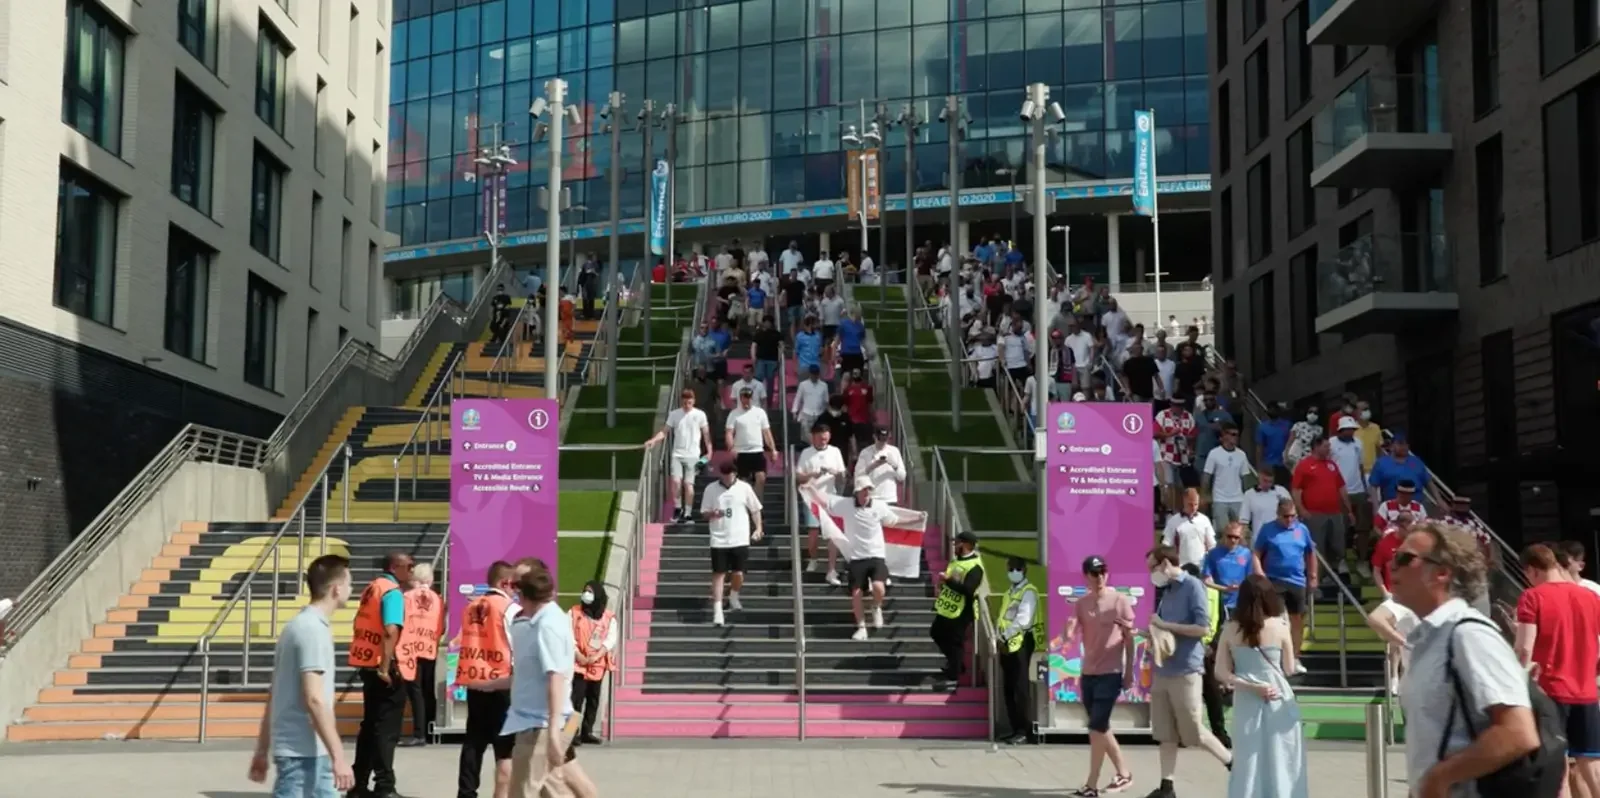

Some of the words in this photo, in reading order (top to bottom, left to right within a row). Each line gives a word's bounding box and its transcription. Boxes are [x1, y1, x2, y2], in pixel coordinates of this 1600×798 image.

[1139, 138, 1149, 197] Entrance
[913, 196, 941, 208] UEFA
[941, 194, 969, 206] EO
[969, 192, 996, 204] 2020
[654, 182, 667, 238] Entrance
[700, 214, 724, 226] UEFA
[723, 212, 749, 224] EURO
[749, 210, 773, 221] 2020
[474, 442, 504, 450] Entrance
[1069, 445, 1100, 453] Entrance
[1070, 466, 1106, 474] Accredited
[473, 484, 508, 492] Accessible
[509, 484, 531, 492] Route
